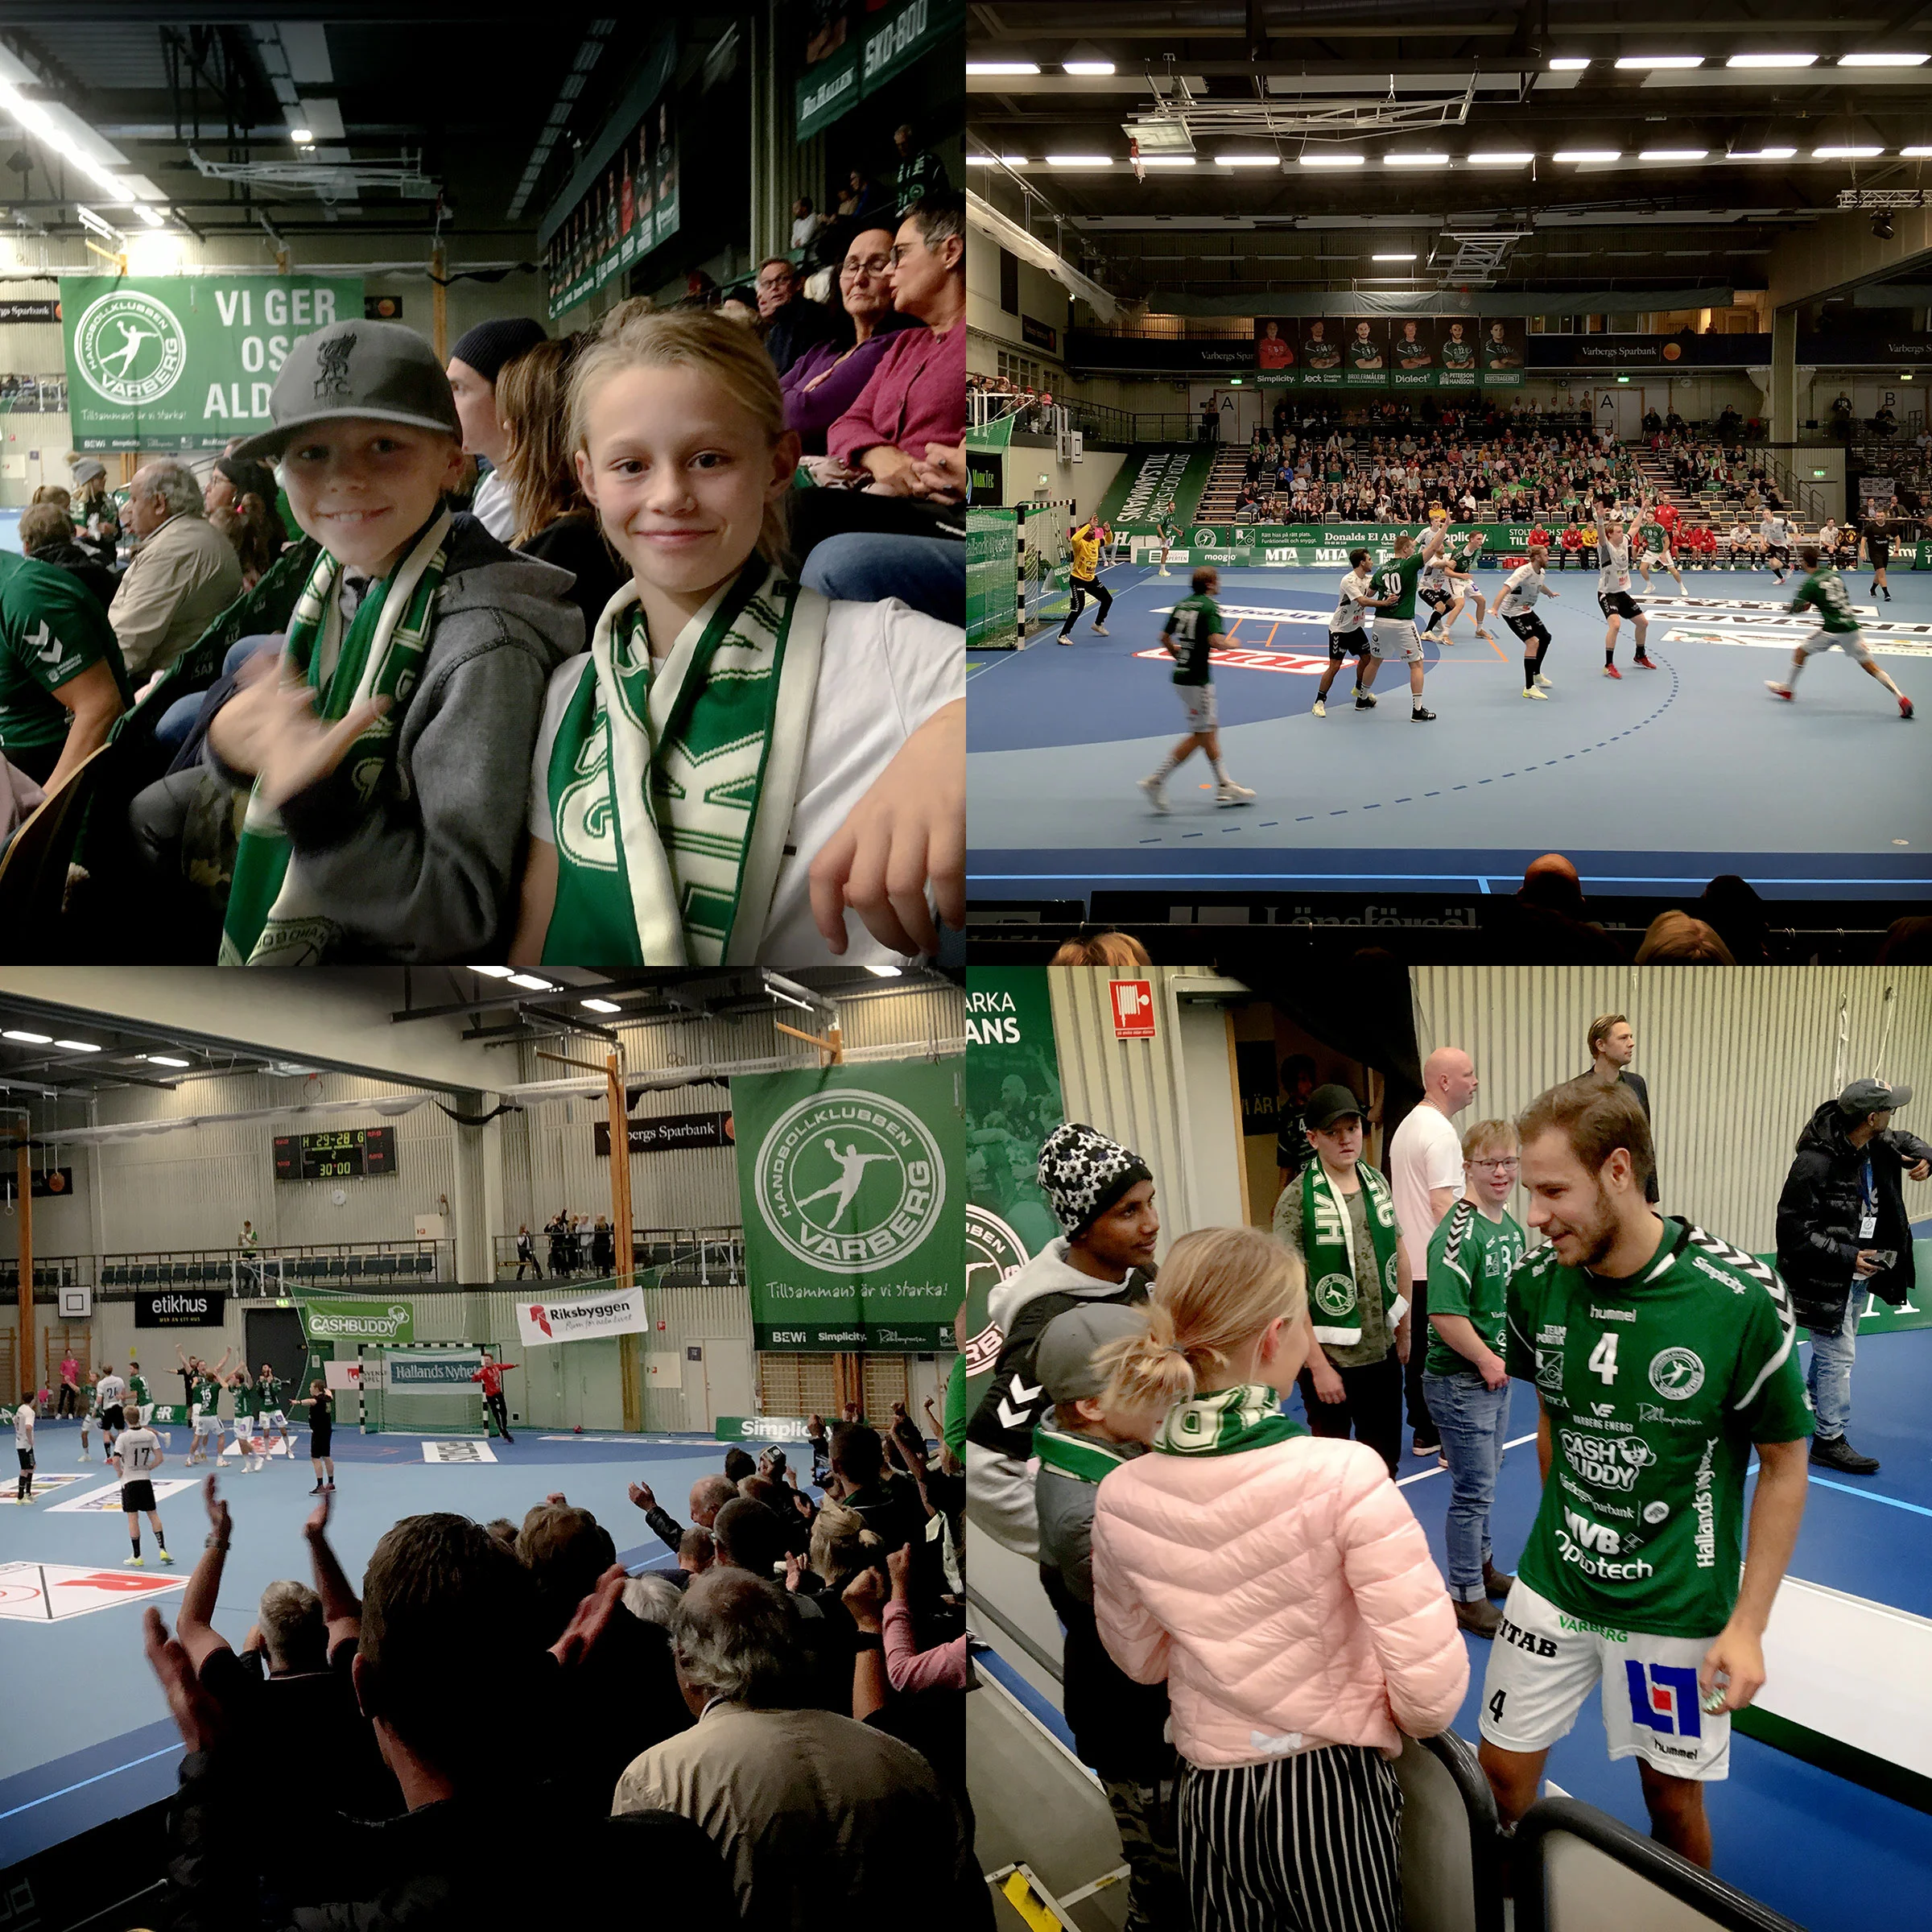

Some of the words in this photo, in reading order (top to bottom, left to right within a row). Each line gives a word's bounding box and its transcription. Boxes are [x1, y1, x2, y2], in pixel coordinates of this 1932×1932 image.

[215, 291, 251, 327] VI
[265, 289, 336, 325] GER
[85, 302, 168, 369] HANDBOLLKLUBBEN
[243, 336, 309, 373] OS
[1201, 351, 1235, 361] Varbergs
[1582, 347, 1617, 357] Varbergs
[1619, 346, 1657, 357] Sparbank
[1889, 344, 1925, 354] Varbergs
[101, 337, 178, 397] VARBERG
[1220, 396, 1234, 411] A
[1600, 394, 1614, 409] A
[1885, 392, 1896, 407] B
[80, 408, 134, 421] Tillsammans
[148, 410, 155, 420] vi
[157, 409, 187, 421] starka!
[1116, 453, 1170, 522] TILLSAMMANS
[1159, 476, 1181, 492] OCH
[1324, 533, 1365, 541] Donalds
[1368, 533, 1377, 541] El
[1381, 533, 1396, 541] AB
[1509, 528, 1530, 536] STOLT
[1265, 548, 1298, 560] MTA
[1315, 548, 1348, 560] MTA
[1381, 572, 1402, 594] 10
[1253, 1093, 1274, 1115] ÄR
[303, 1138, 309, 1148] H
[316, 1132, 350, 1146] 29-28
[357, 1132, 364, 1143] G
[658, 1122, 715, 1141] Sparbank
[772, 1107, 913, 1219] HANDBOLLKLUBBEN
[800, 1160, 931, 1261] VARBERG
[1313, 1191, 1347, 1245] HK
[766, 1282, 857, 1299] Tillsammans
[861, 1282, 876, 1298] är
[881, 1283, 891, 1297] vi
[896, 1280, 948, 1298] starka!
[152, 1294, 207, 1313] etikhus
[550, 1300, 630, 1321] Riksbyggen
[309, 1316, 396, 1335] CASHBUDDY
[818, 1332, 867, 1343] Simplicity.
[1587, 1332, 1619, 1385] 4
[396, 1365, 444, 1378] Hallands
[200, 1388, 212, 1400] 15
[133, 1448, 150, 1466] 17
[1562, 1434, 1617, 1465] CASH
[1692, 1490, 1715, 1569] Hallands
[1558, 1615, 1629, 1643] VARBERG
[1488, 1689, 1507, 1724] 4
[1654, 1739, 1698, 1761] hummel
